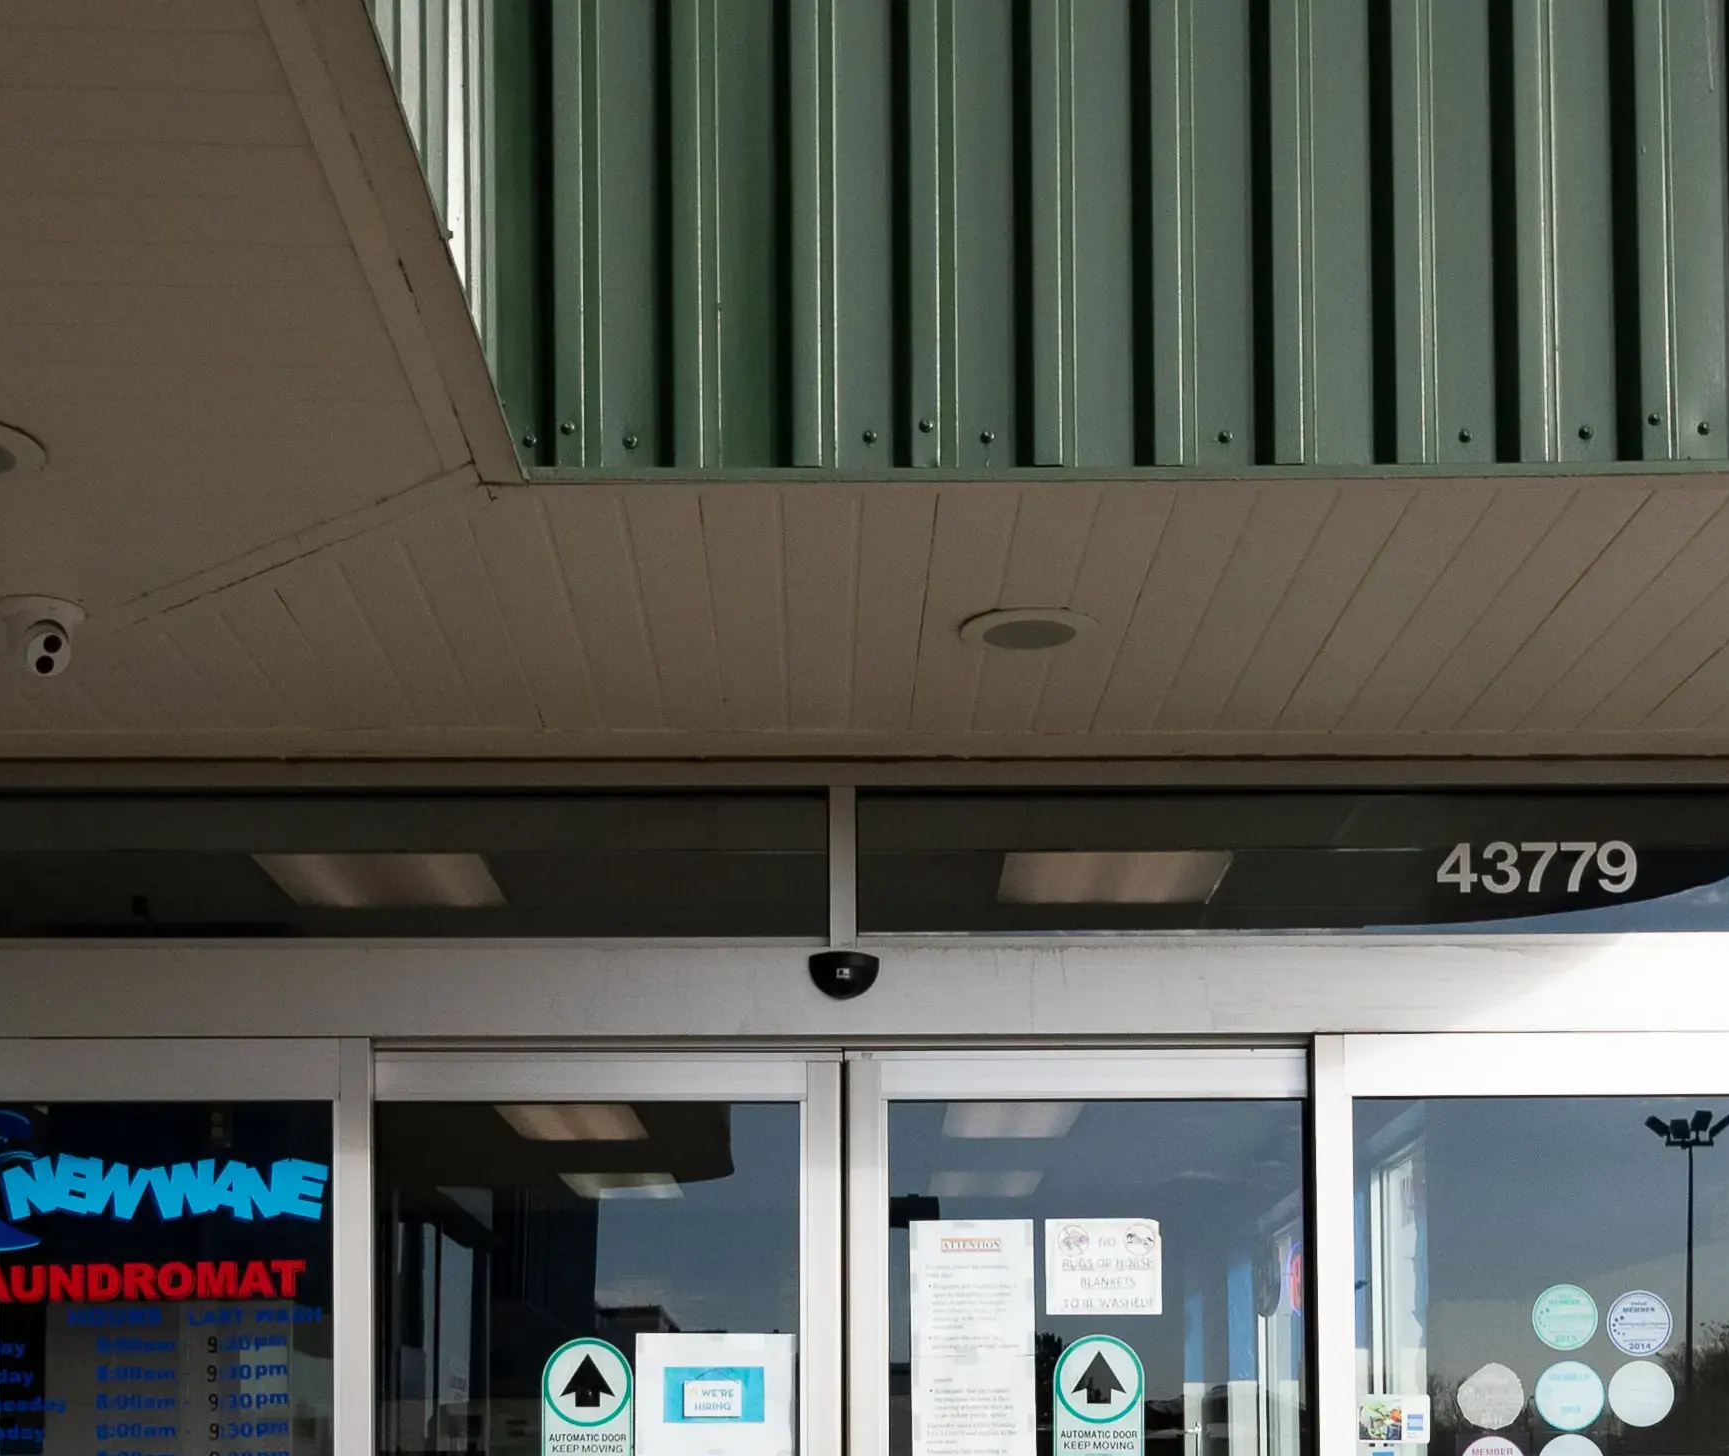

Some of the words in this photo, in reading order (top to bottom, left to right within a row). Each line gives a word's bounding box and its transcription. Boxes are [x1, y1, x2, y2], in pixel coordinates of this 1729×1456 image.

[1437, 840, 1638, 894] 43779
[942, 1240, 1001, 1250] ATTENTION
[1098, 1237, 1117, 1248] NO
[1061, 1257, 1095, 1270] RUGS
[1115, 1257, 1153, 1269] HORSE
[1080, 1276, 1136, 1288] BLANKETS
[1063, 1298, 1080, 1308] TO
[1622, 1306, 1656, 1314] MEMBER
[67, 1308, 163, 1326] HOURS
[187, 1308, 244, 1326] LAST
[255, 1305, 323, 1325] WASH
[701, 1388, 735, 1398] WE'RE
[694, 1402, 732, 1411] HIRING
[549, 1433, 600, 1442] AUTOMATIC
[601, 1433, 627, 1442] DOOR
[1060, 1430, 1111, 1439] AUTOMATIC
[1112, 1430, 1138, 1439] DOOR
[552, 1444, 580, 1453] KEEP
[581, 1444, 624, 1453] MOVING
[1063, 1441, 1091, 1450] KEEP
[1092, 1441, 1135, 1450] MOVING
[1471, 1447, 1514, 1456] MEMBER
